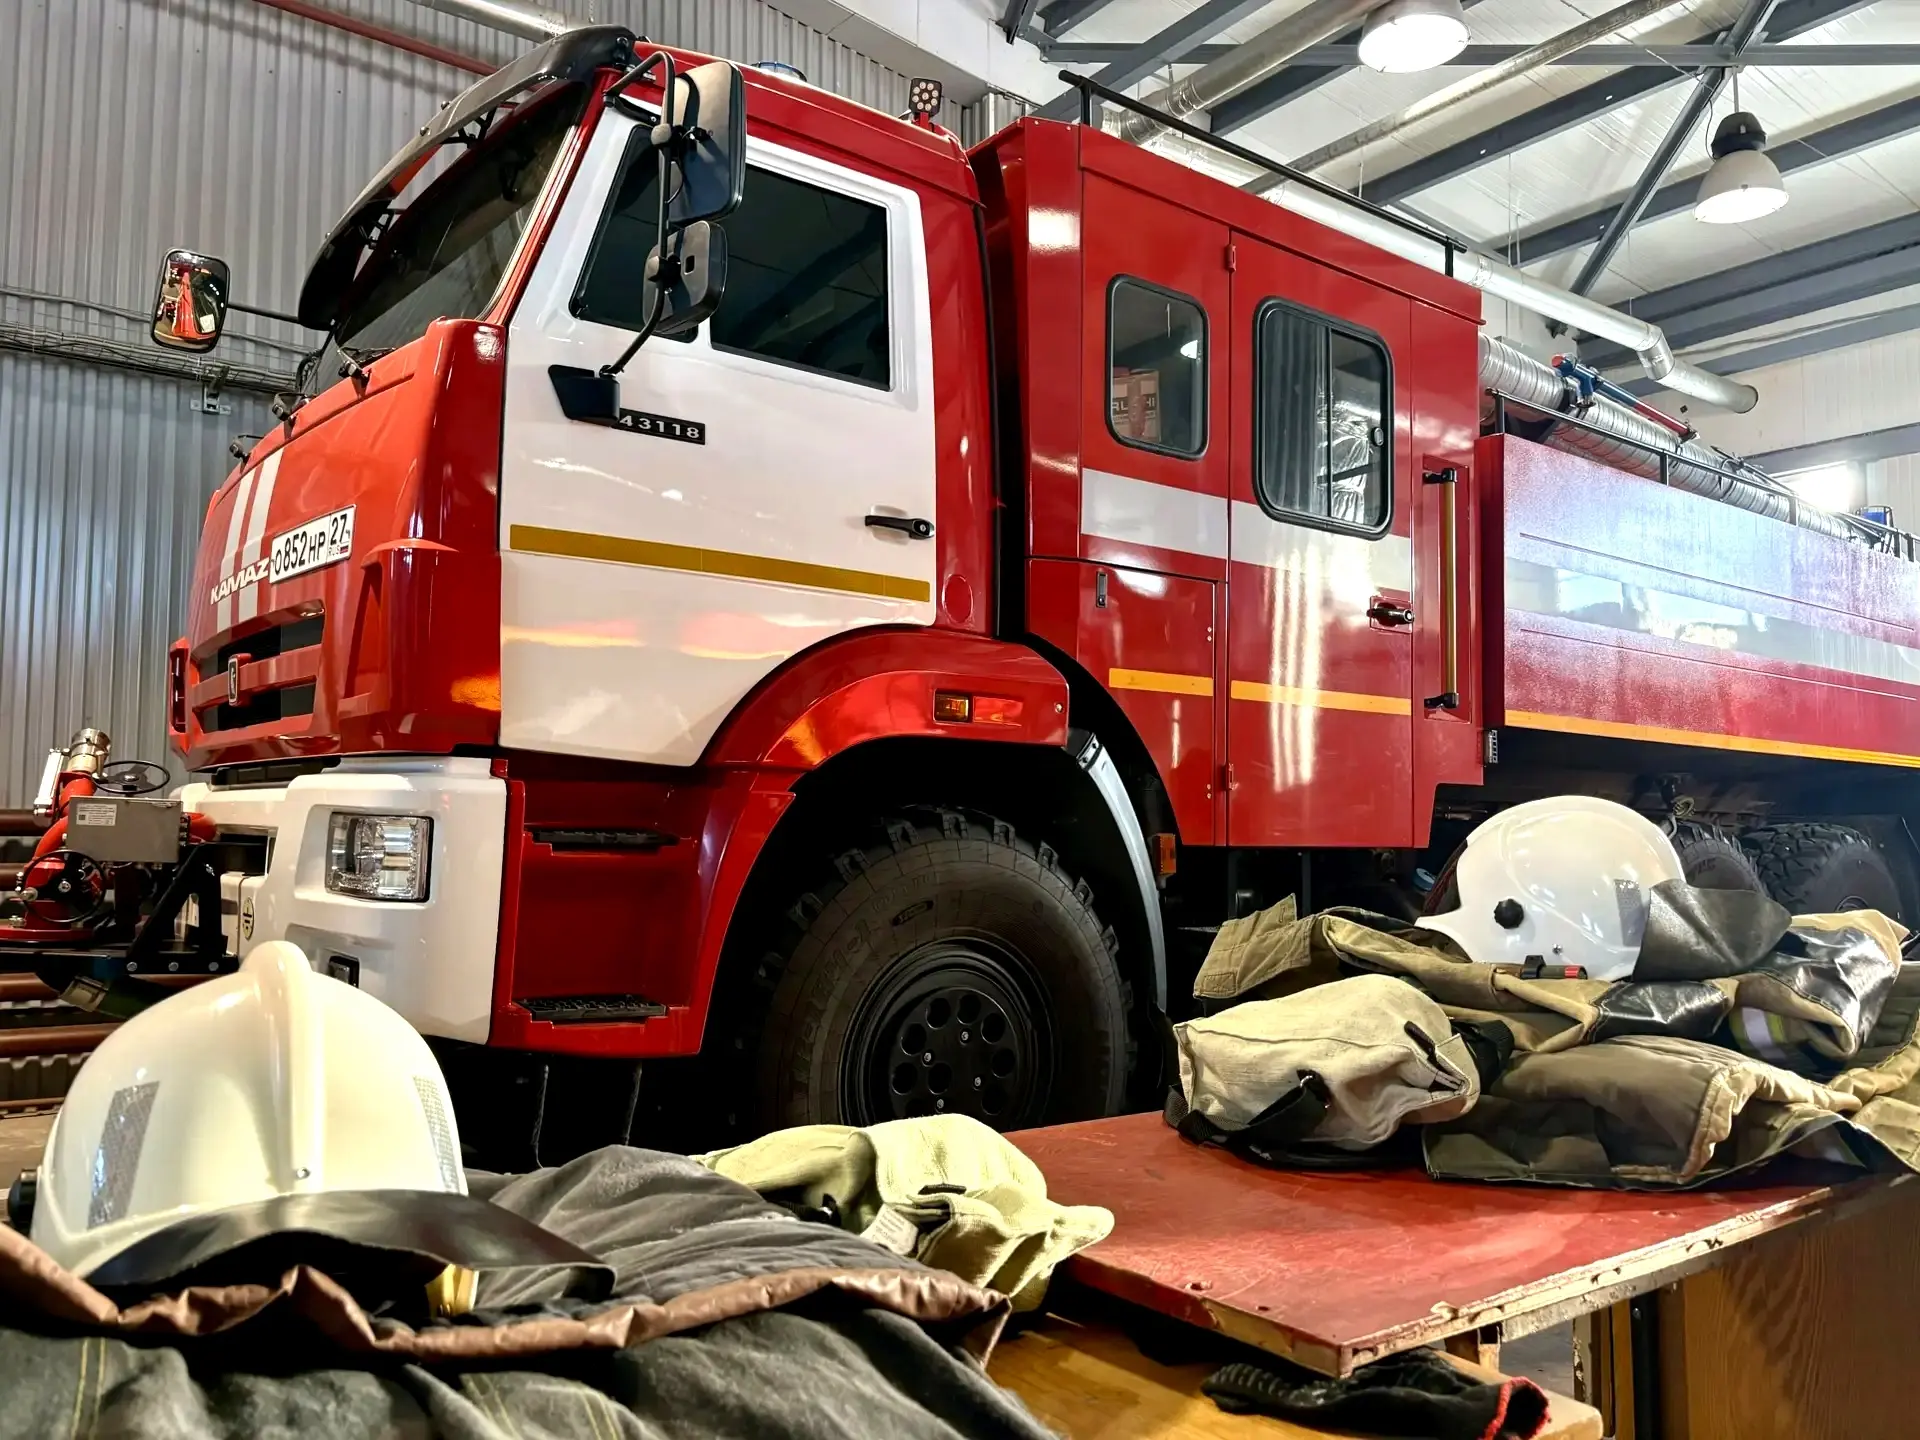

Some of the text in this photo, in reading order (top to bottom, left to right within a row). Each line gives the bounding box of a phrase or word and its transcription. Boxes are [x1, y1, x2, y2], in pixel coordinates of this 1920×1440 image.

[620, 415, 700, 439] 43118
[330, 513, 347, 545] 27
[210, 557, 270, 605] KAMAZ
